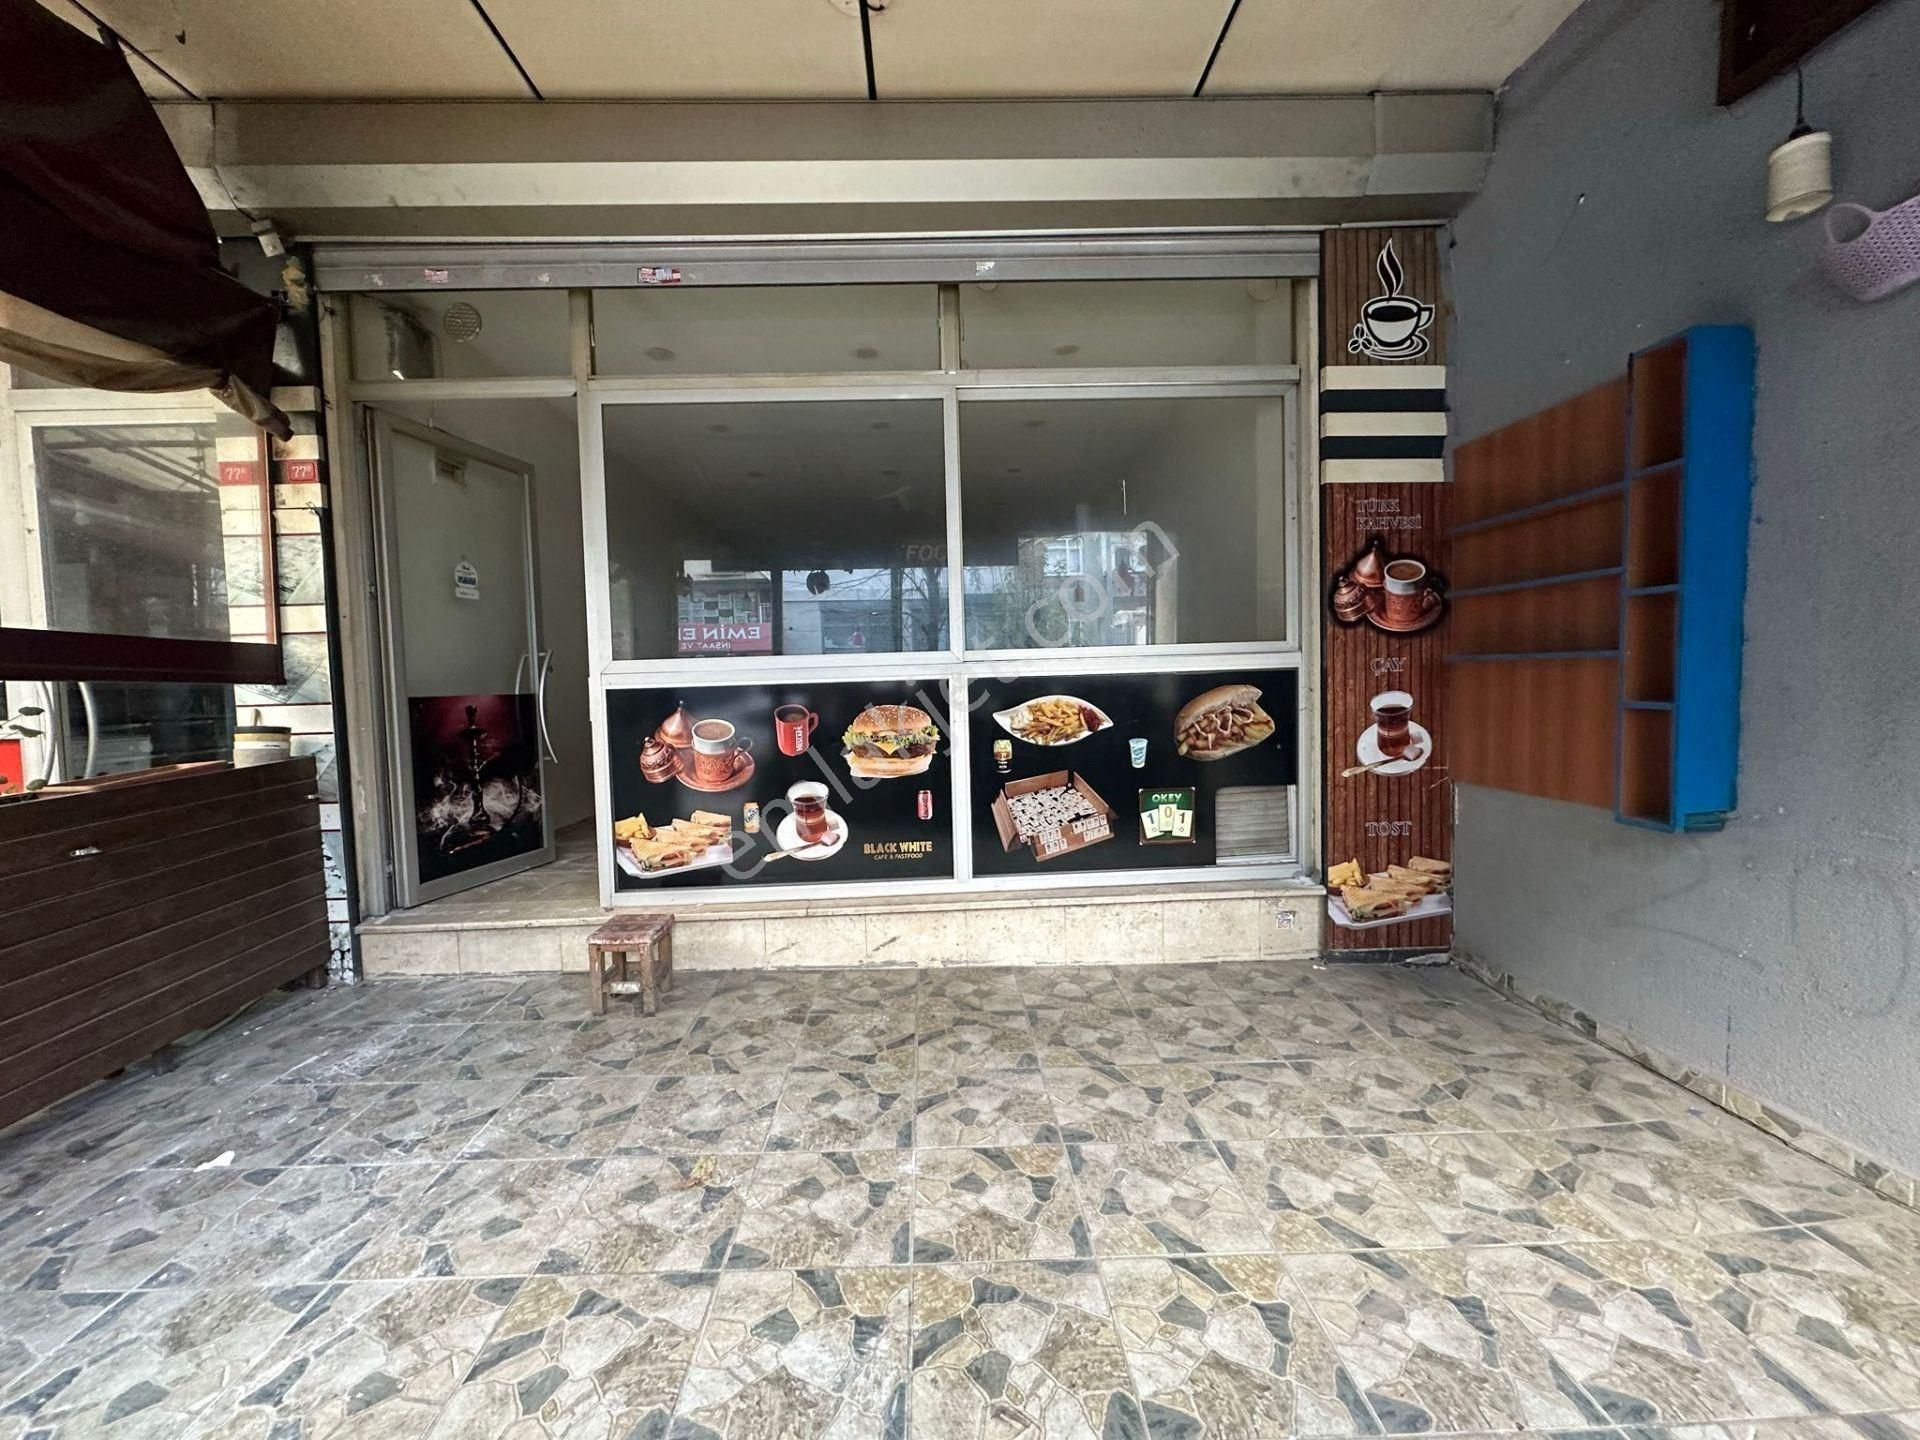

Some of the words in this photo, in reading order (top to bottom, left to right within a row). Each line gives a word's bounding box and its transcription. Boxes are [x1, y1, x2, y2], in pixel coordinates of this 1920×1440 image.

[1370, 657, 1407, 677] ÇAY
[1151, 793, 1182, 803] OKEY
[1365, 820, 1413, 838] TOST
[863, 842, 898, 854] BLACK
[899, 840, 933, 853] WHITE
